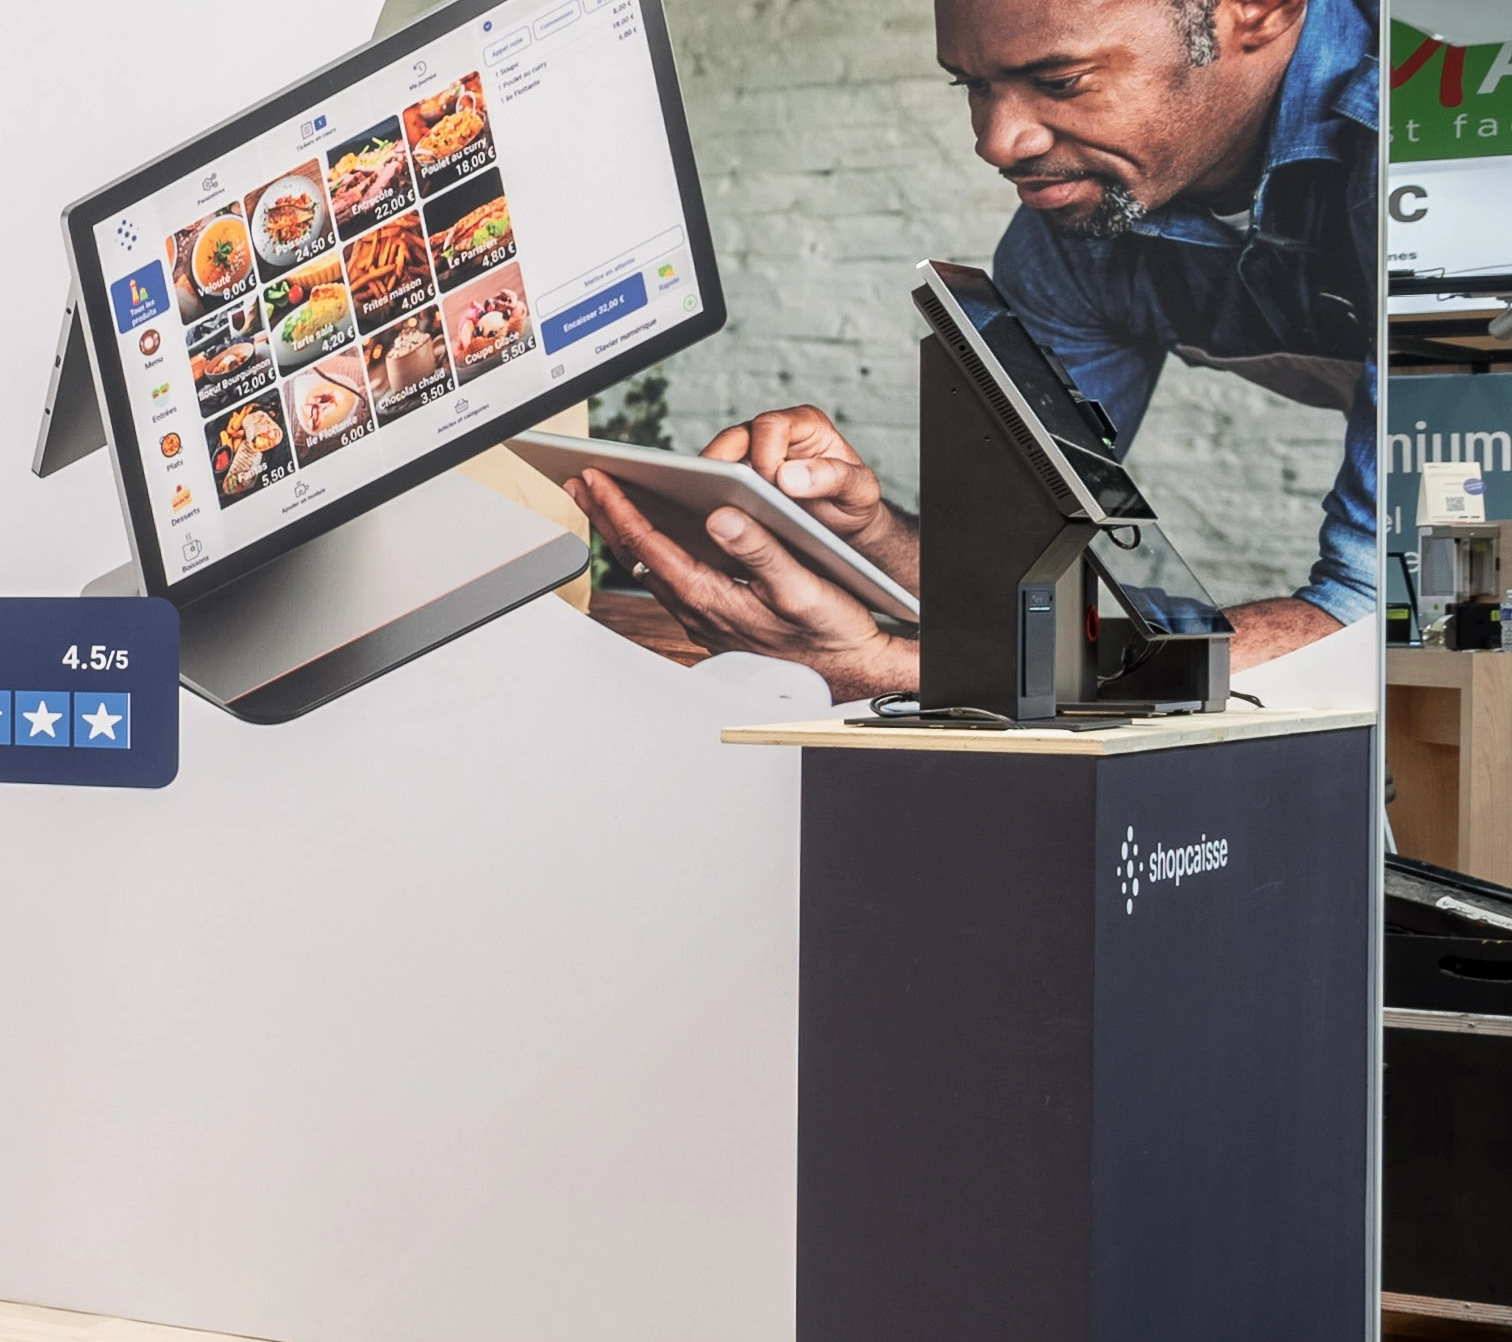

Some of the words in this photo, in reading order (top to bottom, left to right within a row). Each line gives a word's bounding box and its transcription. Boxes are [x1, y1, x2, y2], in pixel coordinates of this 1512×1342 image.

[421, 156, 451, 179] Poulet
[464, 137, 488, 156] curry
[456, 152, 486, 176] 18,00
[487, 146, 496, 158] €
[351, 187, 394, 216] Entrecôte
[374, 195, 406, 221] 22,00
[407, 189, 415, 202] €
[448, 255, 461, 270] Le
[198, 274, 231, 297] Velouté
[363, 294, 389, 314] Frites
[390, 277, 422, 299] maison
[379, 383, 417, 410] Chocolat
[418, 369, 446, 389] chaud
[62, 645, 129, 671] 4.5/5
[1148, 833, 1229, 887] shopcaisse
